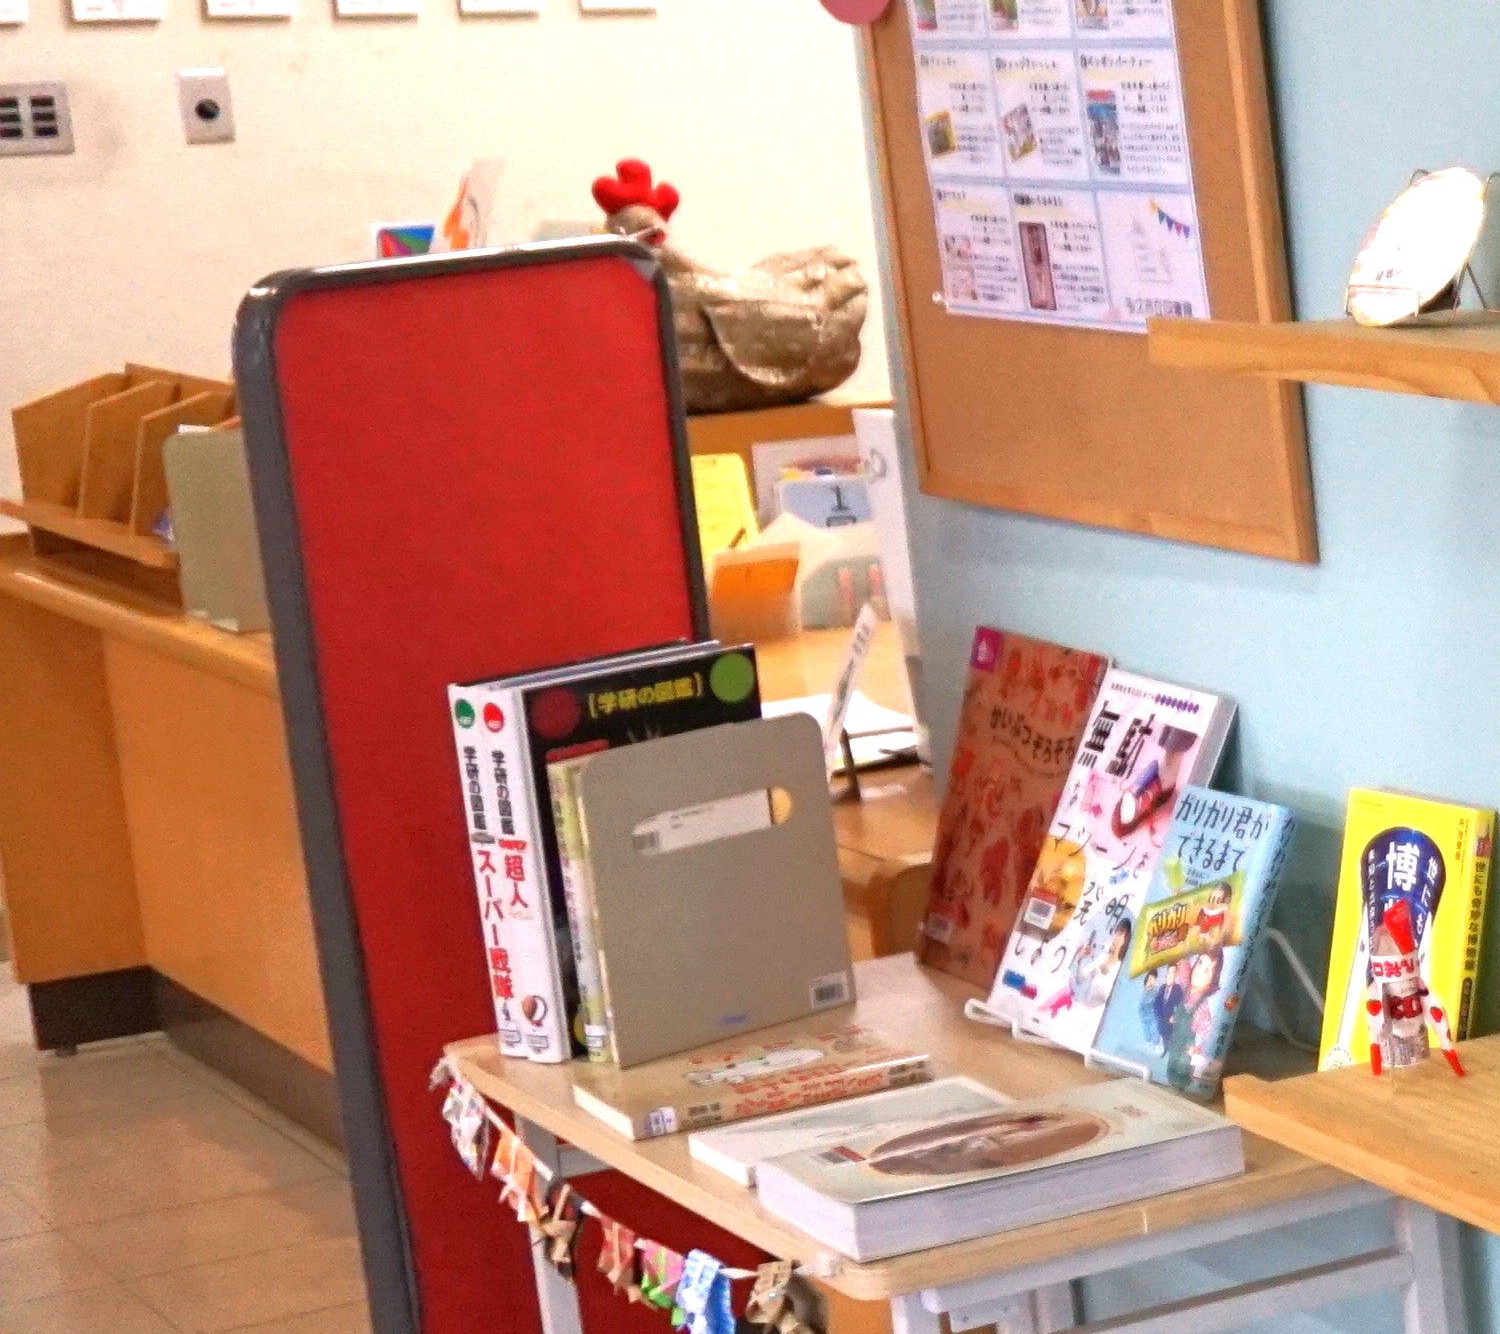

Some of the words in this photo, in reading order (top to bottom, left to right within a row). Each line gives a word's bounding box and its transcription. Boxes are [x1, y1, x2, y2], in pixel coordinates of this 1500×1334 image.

[1076, 699, 1157, 779] 無駄
[1175, 793, 1272, 841] ガリガリ君が
[1177, 833, 1248, 873] できるまで
